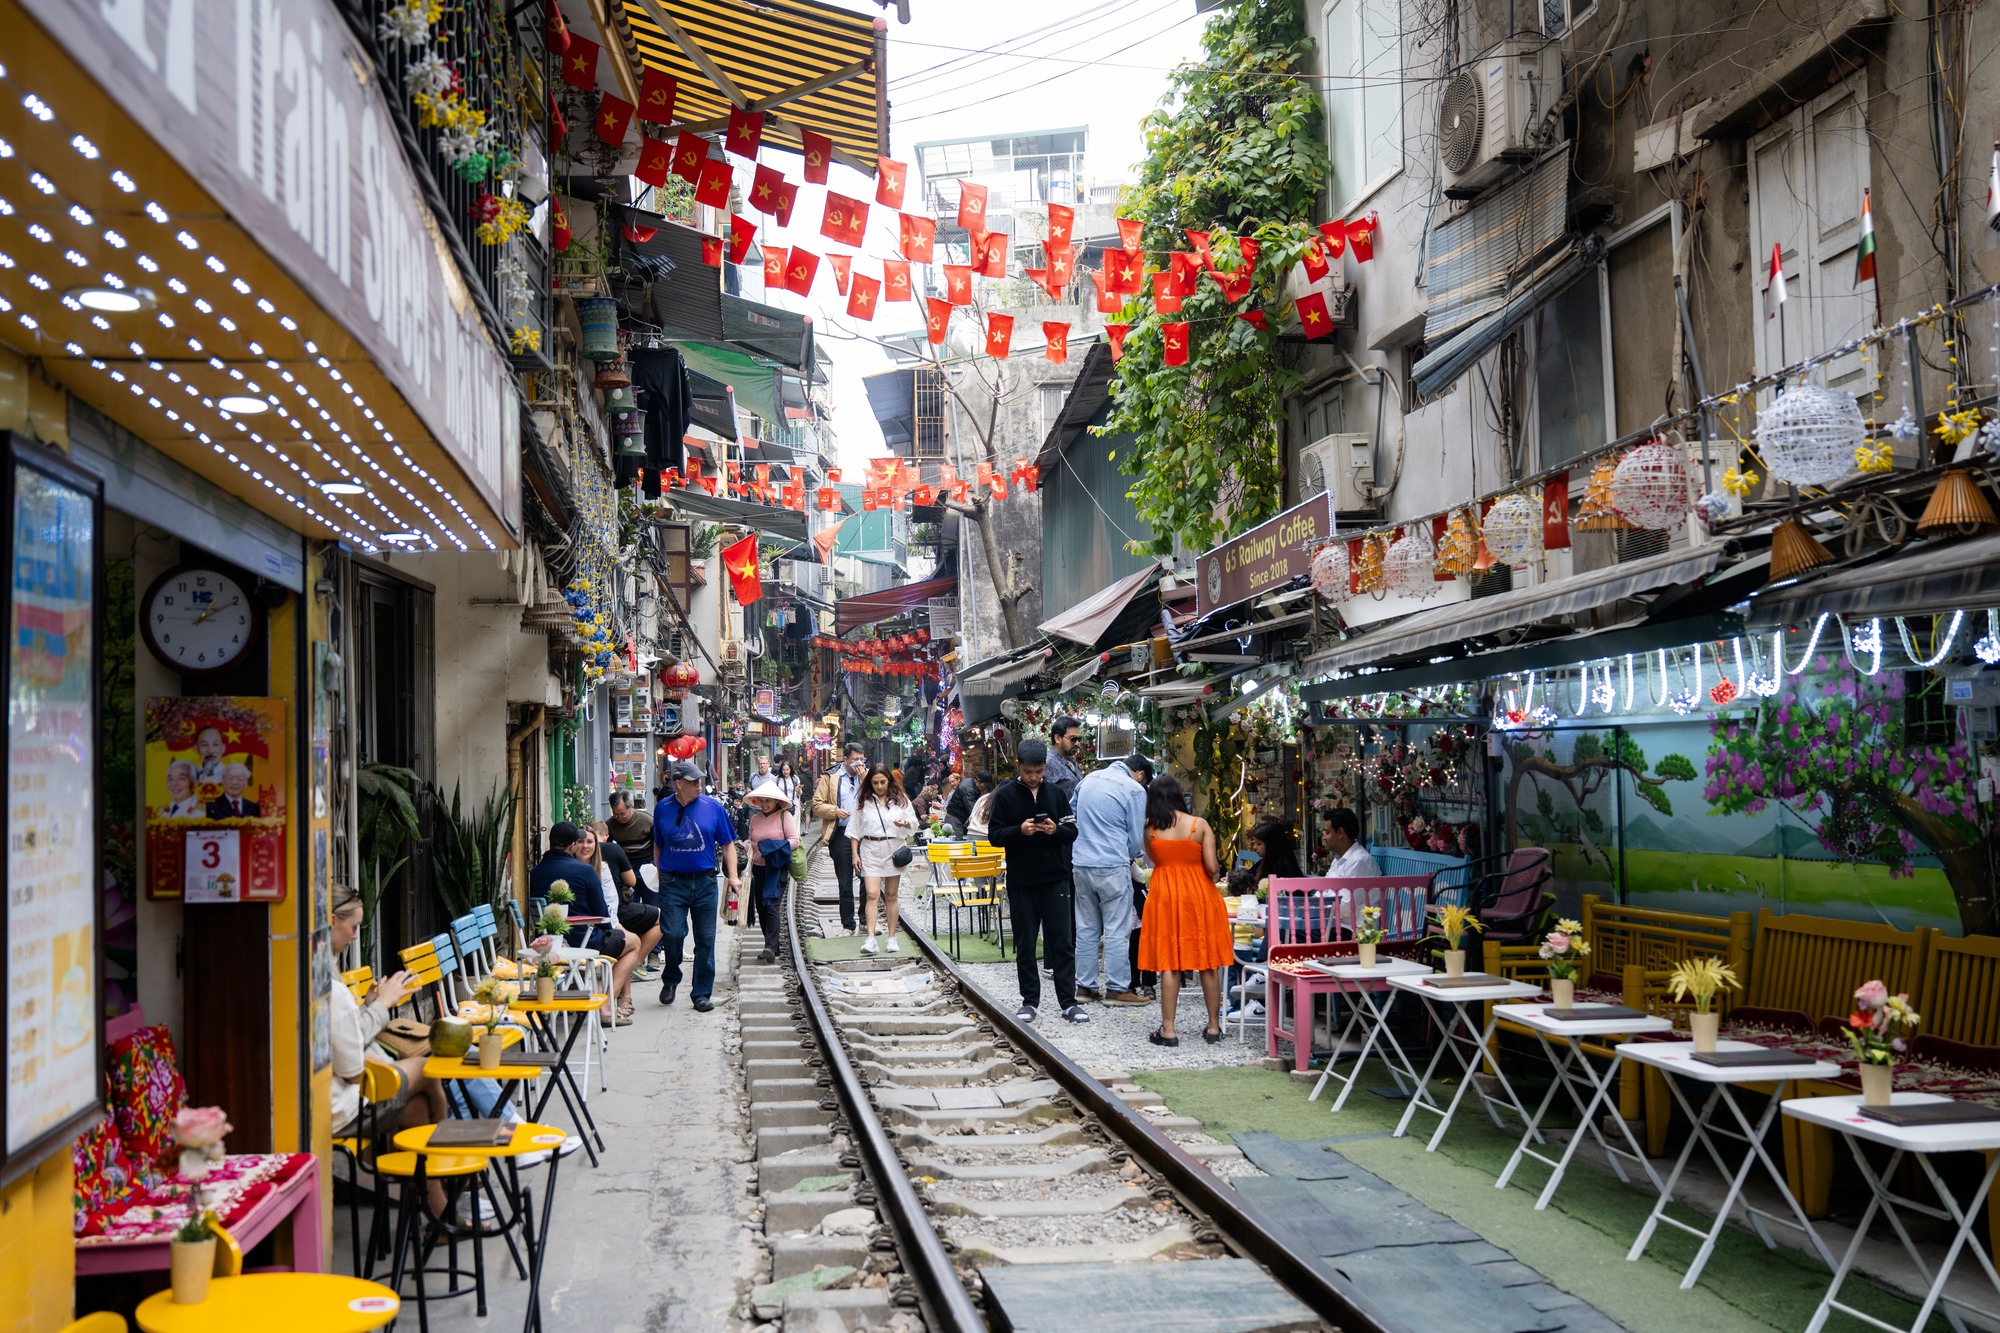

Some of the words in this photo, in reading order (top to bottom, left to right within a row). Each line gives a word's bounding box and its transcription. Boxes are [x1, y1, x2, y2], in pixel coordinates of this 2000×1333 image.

[361, 104, 432, 401] Street
[1225, 548, 1237, 573] 65
[1239, 533, 1277, 567] Railway
[1279, 514, 1316, 549] Coffee
[1249, 570, 1269, 590] Since
[1270, 558, 1289, 581] 2018
[196, 577, 206, 587] 12
[219, 582, 223, 592] 1
[178, 582, 187, 593] 11
[164, 596, 174, 606] 10
[232, 596, 240, 606] 2
[157, 614, 164, 624] 9
[239, 615, 245, 625] 3
[163, 633, 171, 643] 8
[231, 634, 239, 644] 4
[179, 646, 185, 656] 7
[218, 648, 225, 657] 5
[198, 652, 205, 662] 6
[201, 841, 221, 869] 3
